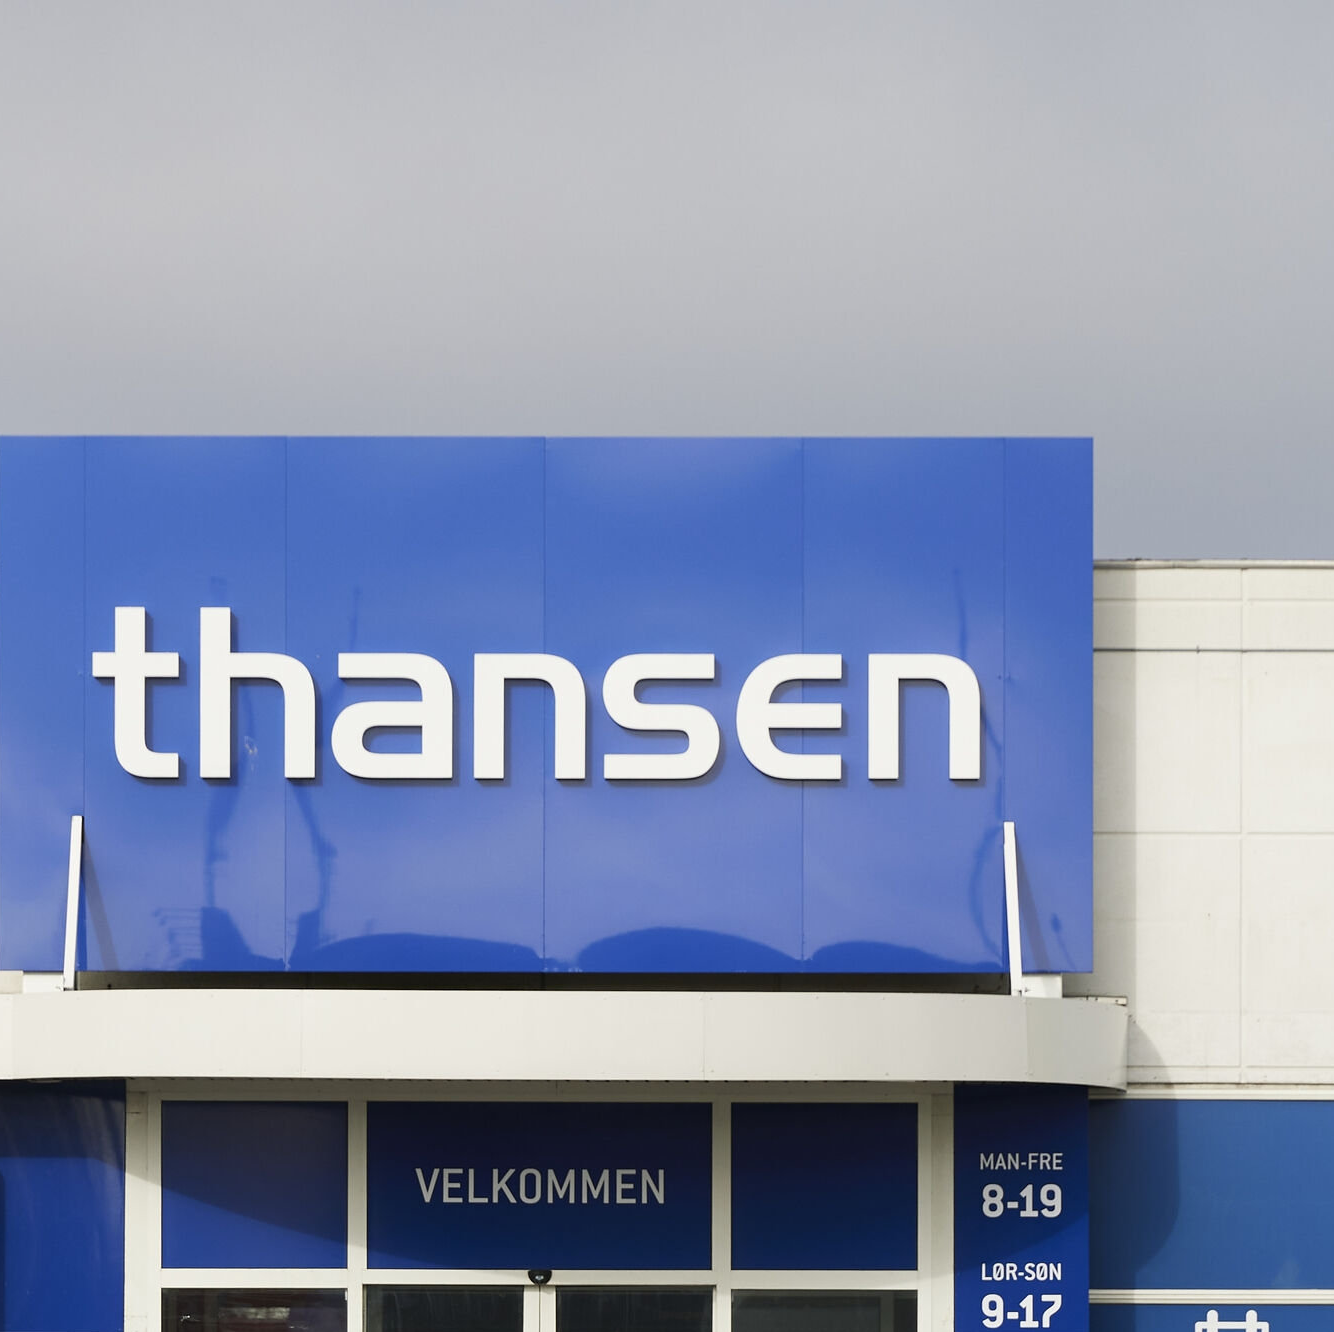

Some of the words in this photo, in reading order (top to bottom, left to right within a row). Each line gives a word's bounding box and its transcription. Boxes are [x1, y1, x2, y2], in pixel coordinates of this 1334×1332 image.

[92, 607, 981, 781] thansen
[980, 1153, 1063, 1170] MAN-FRE
[415, 1168, 665, 1204] VELKOMMEN
[982, 1184, 1062, 1218] 8-19
[981, 1263, 1062, 1281] LØR-SØN
[981, 1294, 1062, 1328] 9-17
